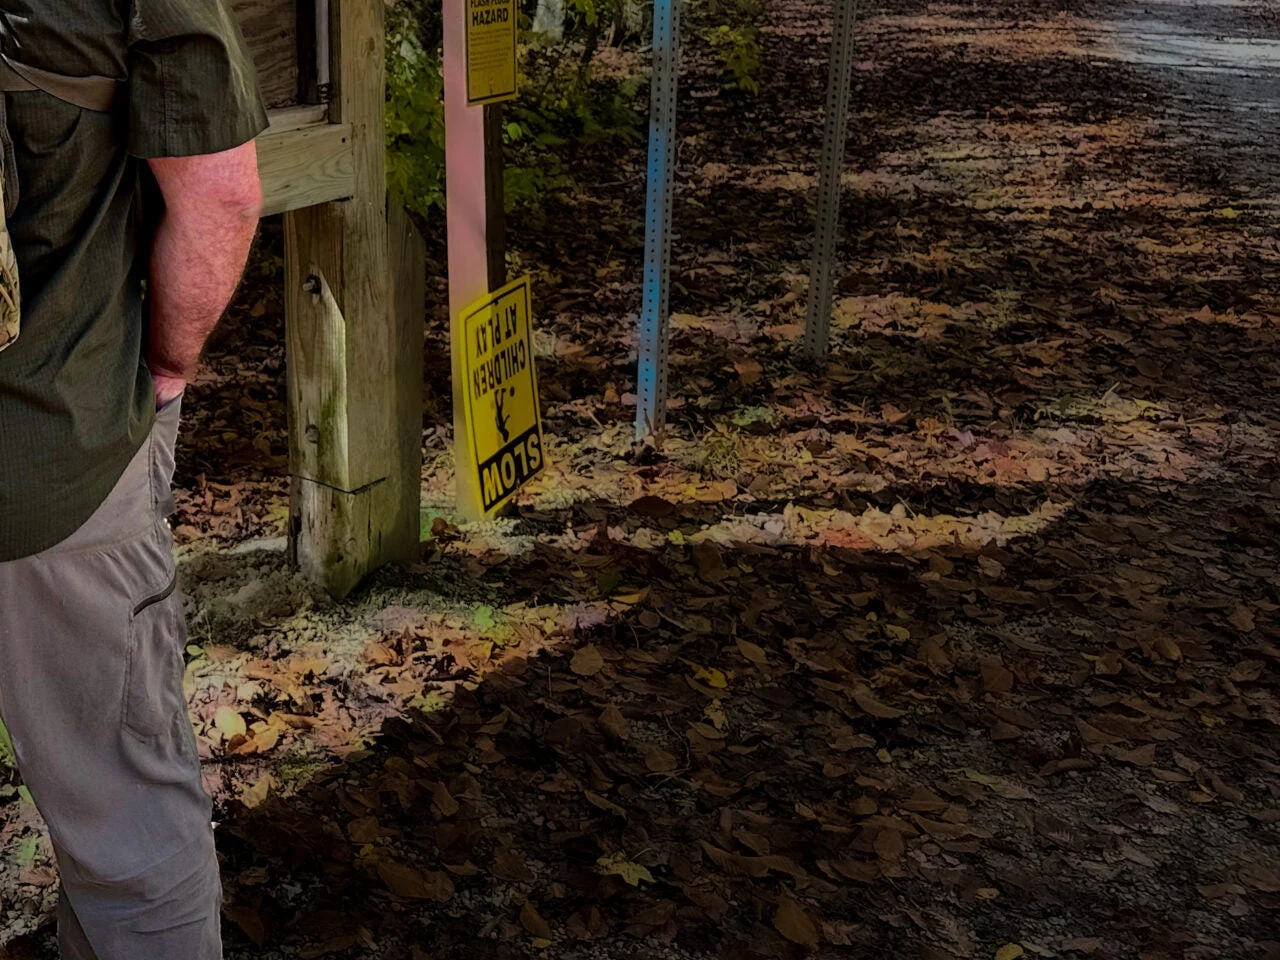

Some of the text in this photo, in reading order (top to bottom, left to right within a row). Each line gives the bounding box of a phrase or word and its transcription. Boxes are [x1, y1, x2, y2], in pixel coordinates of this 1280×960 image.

[472, 7, 509, 26] HAZARD
[475, 303, 518, 358] AT PLAY
[473, 339, 526, 400] CHILDREN
[482, 433, 541, 506] SLOW
